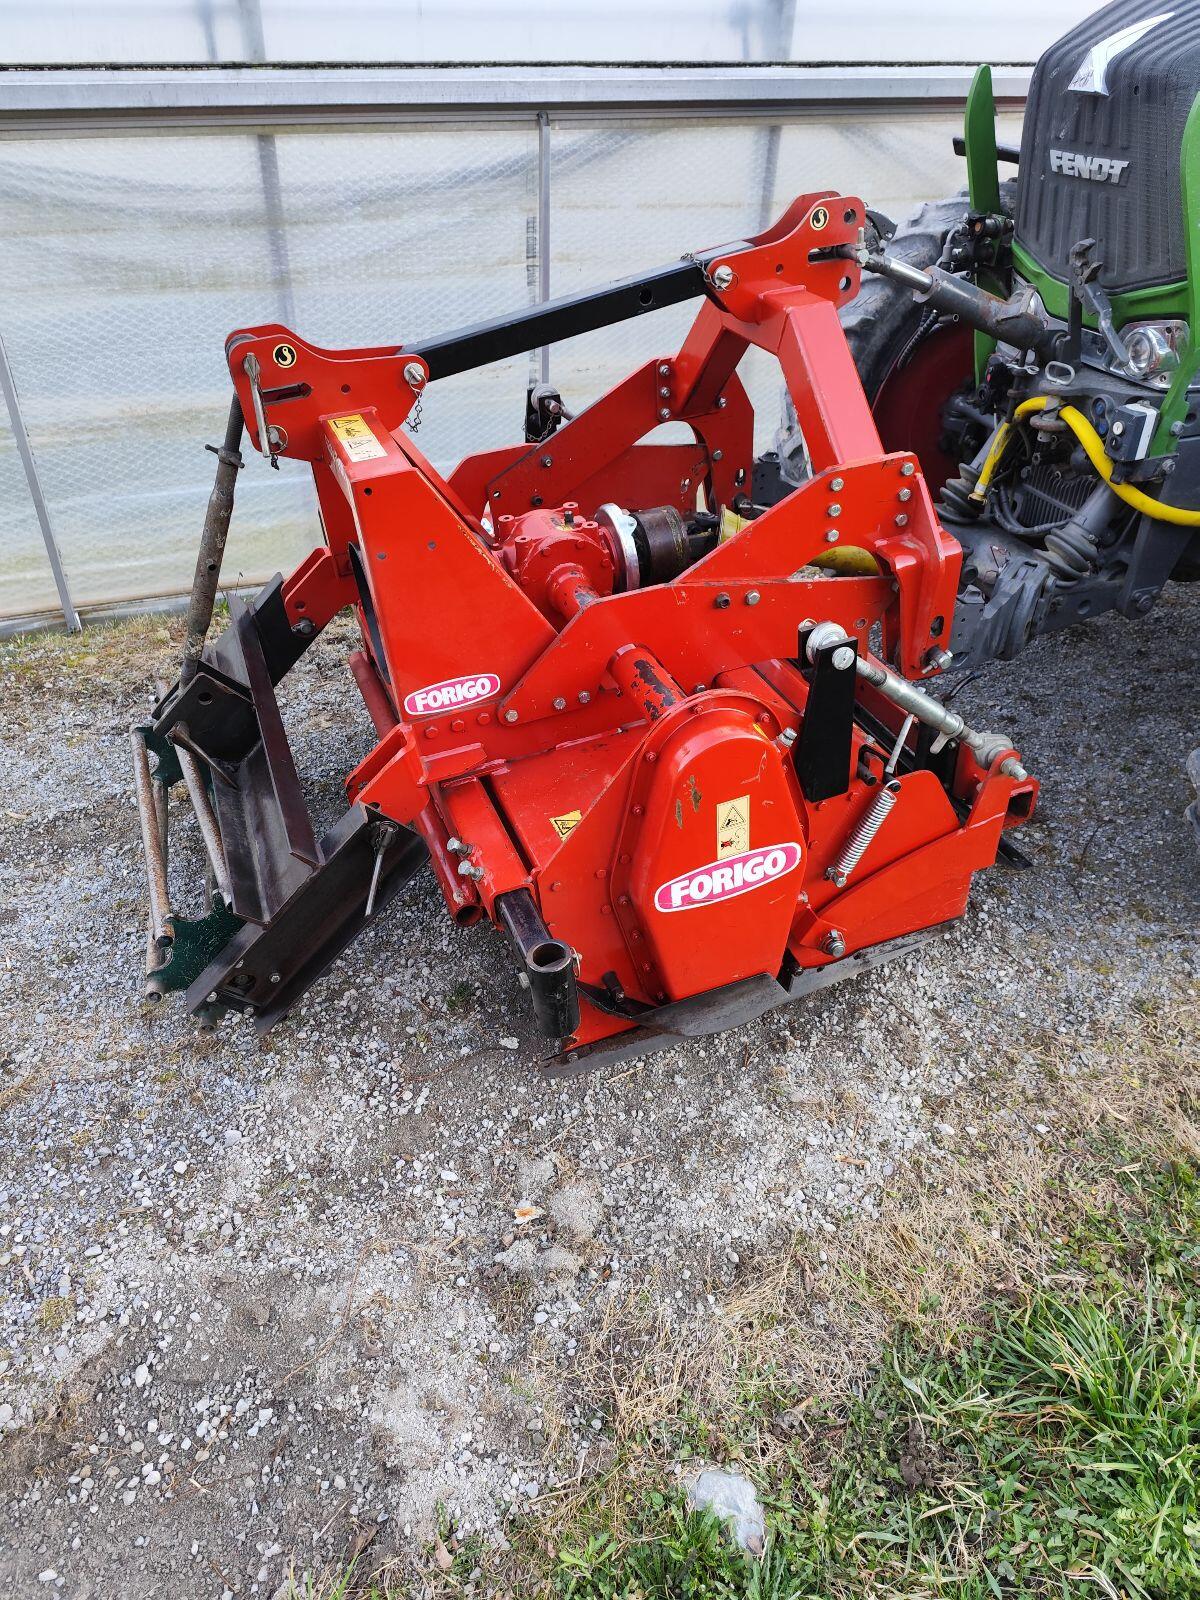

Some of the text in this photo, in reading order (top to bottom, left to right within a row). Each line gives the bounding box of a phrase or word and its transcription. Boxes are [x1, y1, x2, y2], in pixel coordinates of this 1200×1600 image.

[1050, 149, 1129, 184] FENDT
[414, 678, 491, 712] FORIGO
[670, 850, 787, 908] FORIGO
